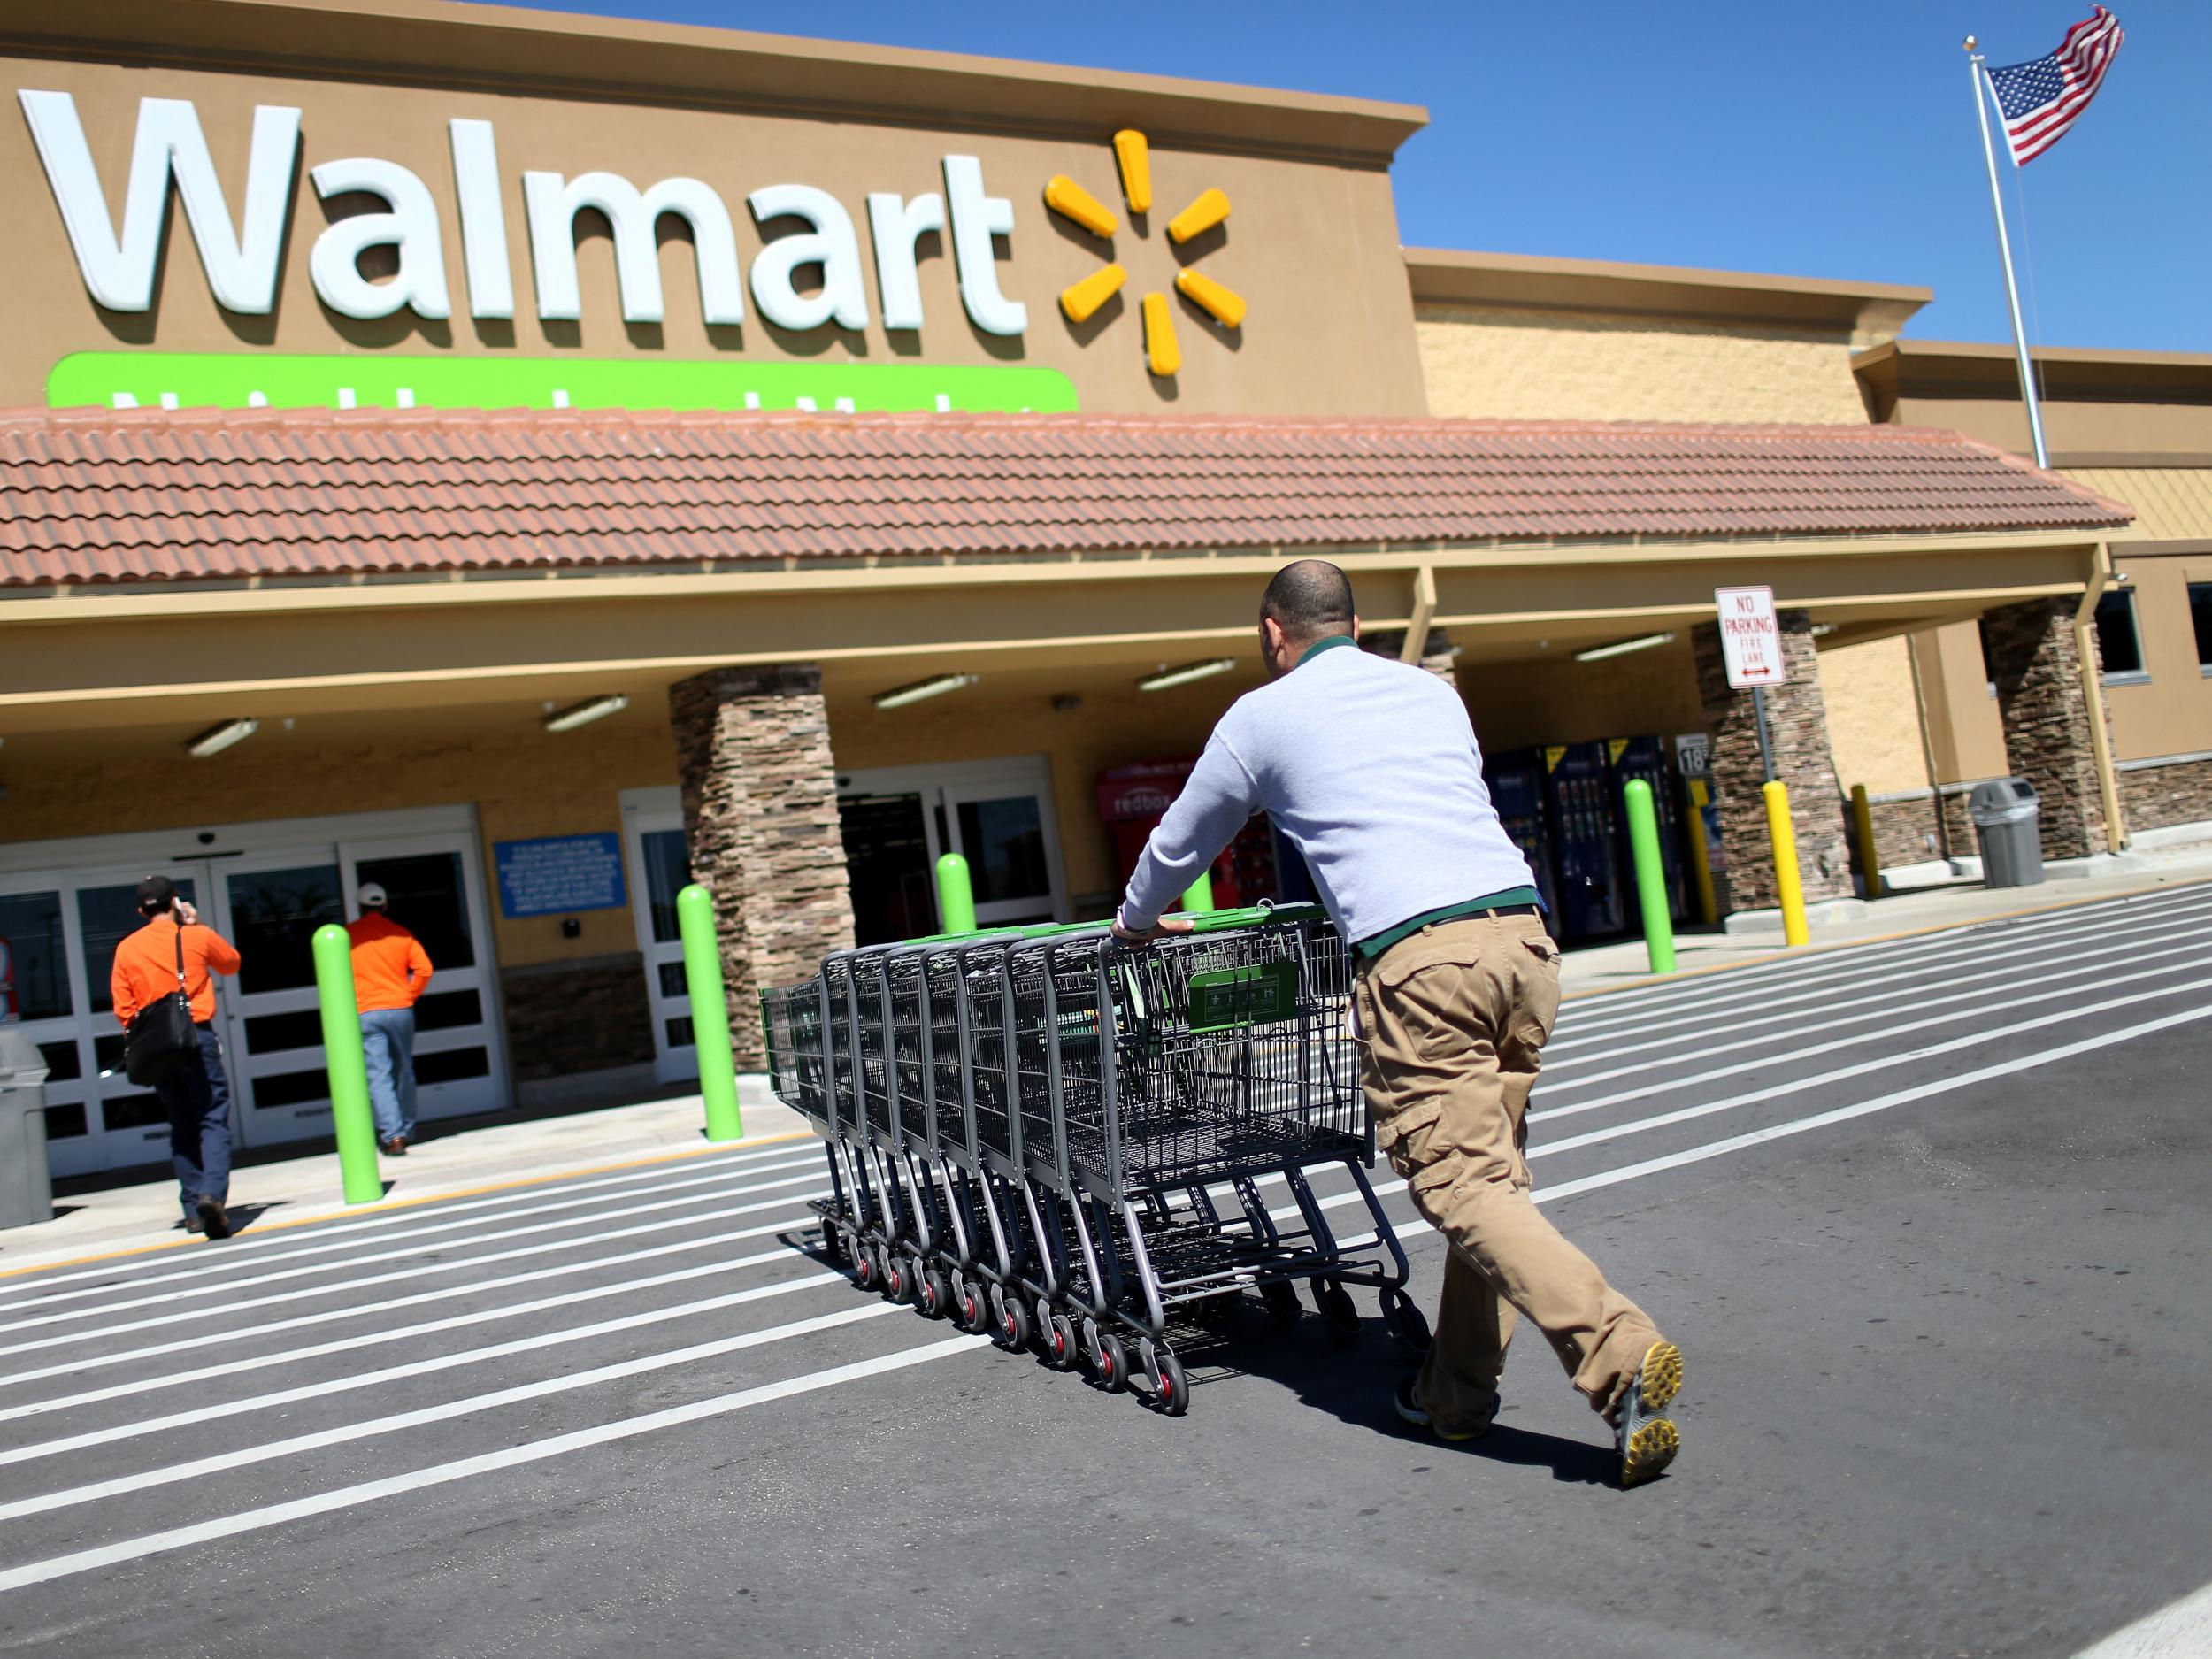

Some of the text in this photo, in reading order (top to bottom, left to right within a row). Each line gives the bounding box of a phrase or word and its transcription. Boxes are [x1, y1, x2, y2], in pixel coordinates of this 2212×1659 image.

[18, 88, 1027, 337] Walmart
[1736, 595, 1755, 613] NO
[1724, 615, 1772, 635] PARKING
[1740, 638, 1763, 651] FIRE
[1742, 652, 1764, 665] LANE
